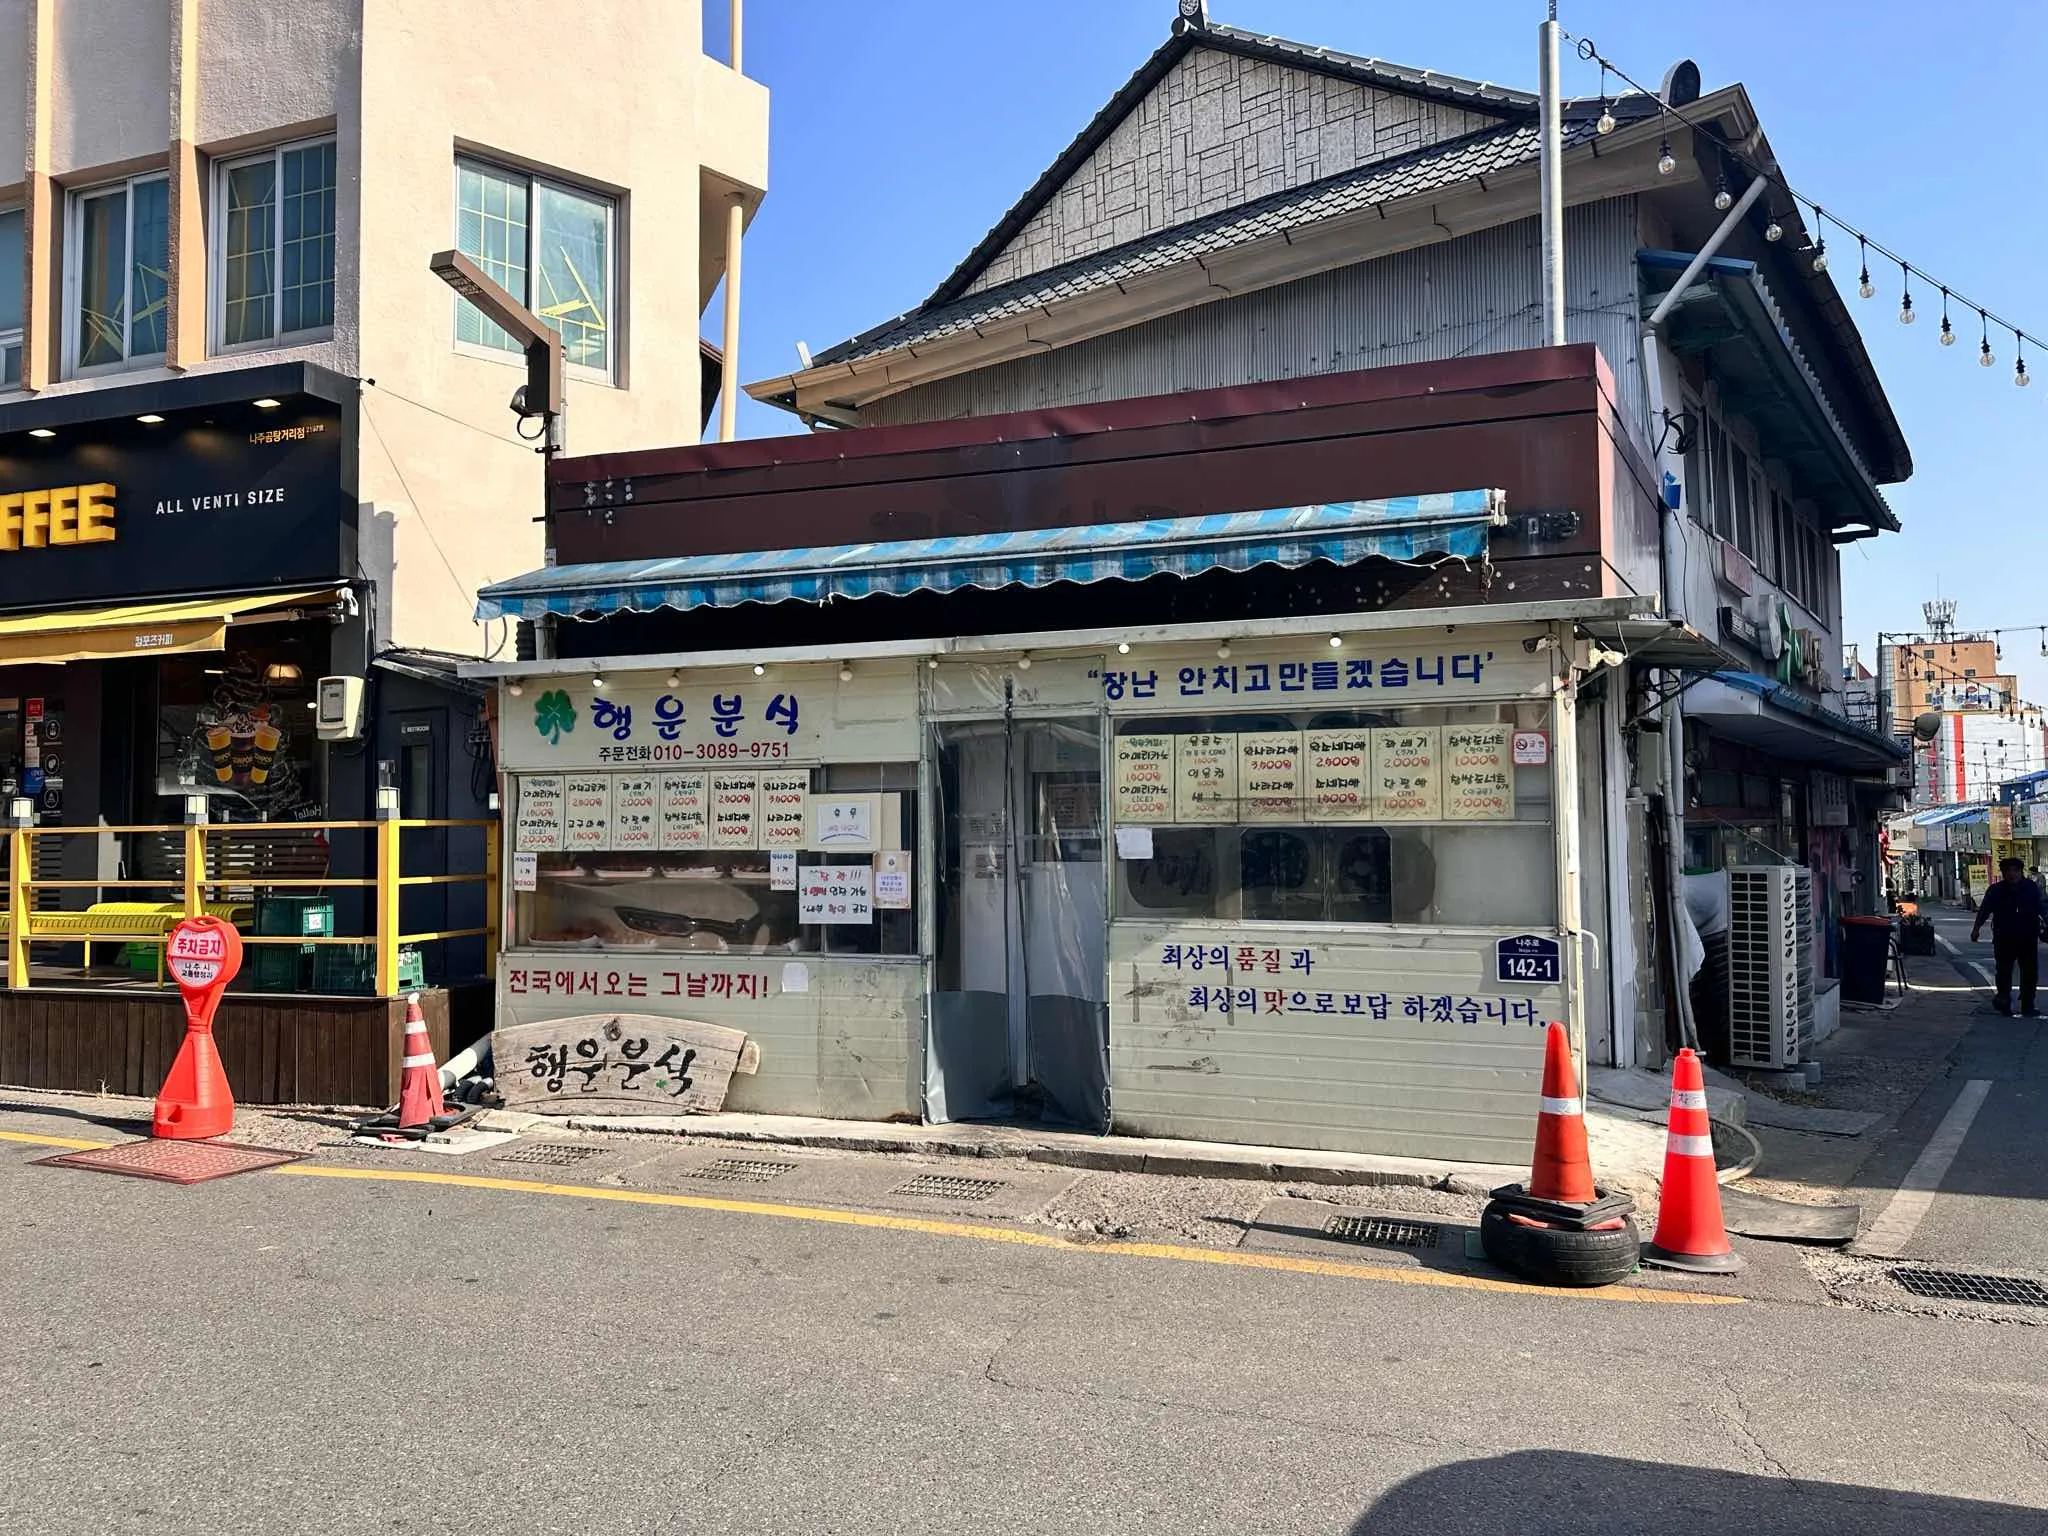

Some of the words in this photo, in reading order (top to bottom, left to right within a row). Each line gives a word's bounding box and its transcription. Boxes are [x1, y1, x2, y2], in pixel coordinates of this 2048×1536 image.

[249, 426, 305, 445] 나주곰탕거리점
[155, 493, 185, 515] ALL
[192, 490, 240, 512] VENTI
[247, 487, 286, 506] SIZE
[1385, 736, 1429, 749] 꽈배기
[1119, 750, 1169, 761] 아메리카노
[1119, 784, 1169, 795] 아메리카노
[1384, 777, 1428, 791] 단팥빵
[177, 938, 222, 955] 주차금지
[1515, 939, 1540, 947] 나주로
[1161, 945, 1230, 973] 최상의
[1507, 958, 1552, 977] 142-1
[509, 968, 649, 998] 전국에서오는
[661, 971, 769, 1000] 그날까지!
[525, 1037, 698, 1097] 행운분식
